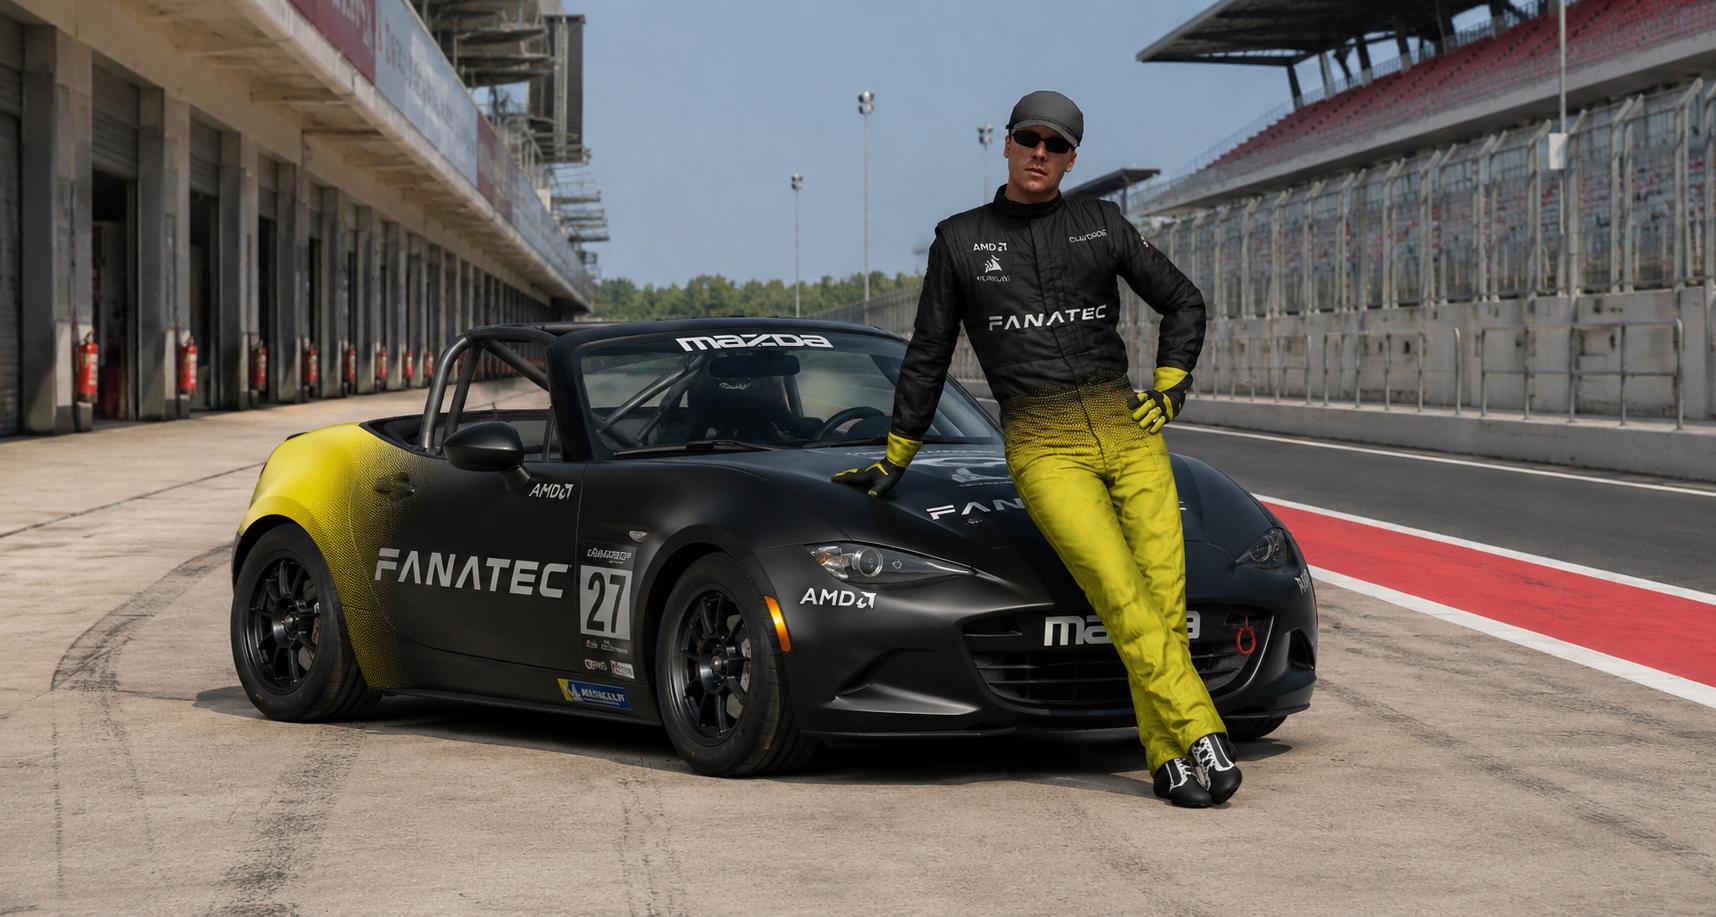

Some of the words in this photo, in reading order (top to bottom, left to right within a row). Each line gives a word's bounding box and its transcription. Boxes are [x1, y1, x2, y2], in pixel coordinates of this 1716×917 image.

[973, 242, 997, 252] AMD
[989, 304, 1107, 331] FANATEC
[529, 482, 561, 498] AMD
[374, 547, 569, 599] FANATEC
[586, 571, 627, 634] 27
[800, 587, 856, 607] AMD
